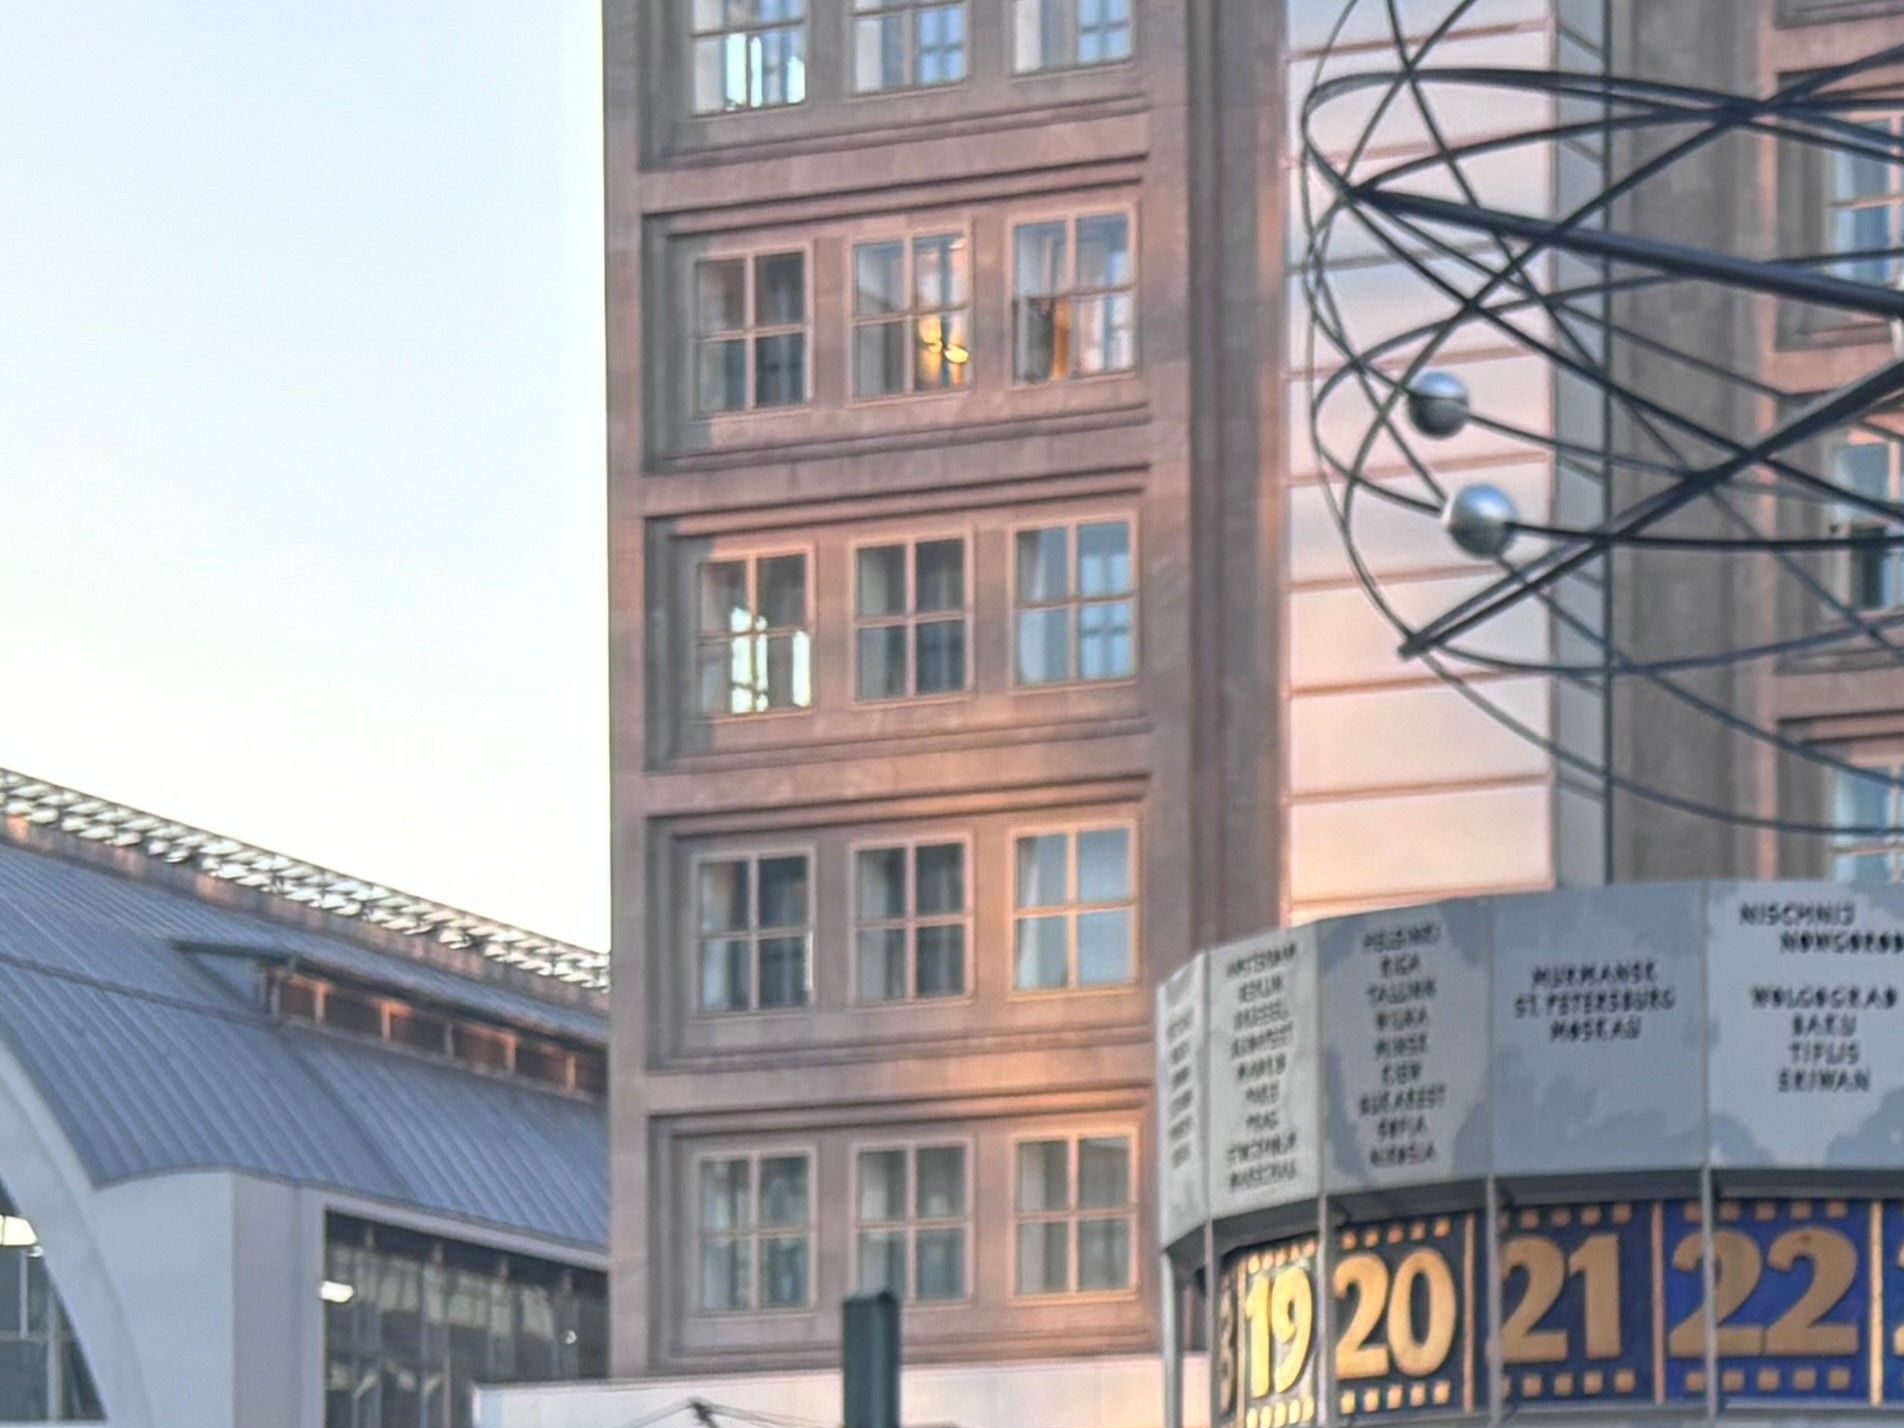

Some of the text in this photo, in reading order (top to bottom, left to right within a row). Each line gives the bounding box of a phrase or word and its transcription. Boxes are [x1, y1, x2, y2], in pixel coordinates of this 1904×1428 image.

[1245, 1265, 1313, 1399] 19
[1335, 1248, 1457, 1380] 20
[1497, 1232, 1625, 1363] 21
[1669, 1225, 1859, 1358] 22
